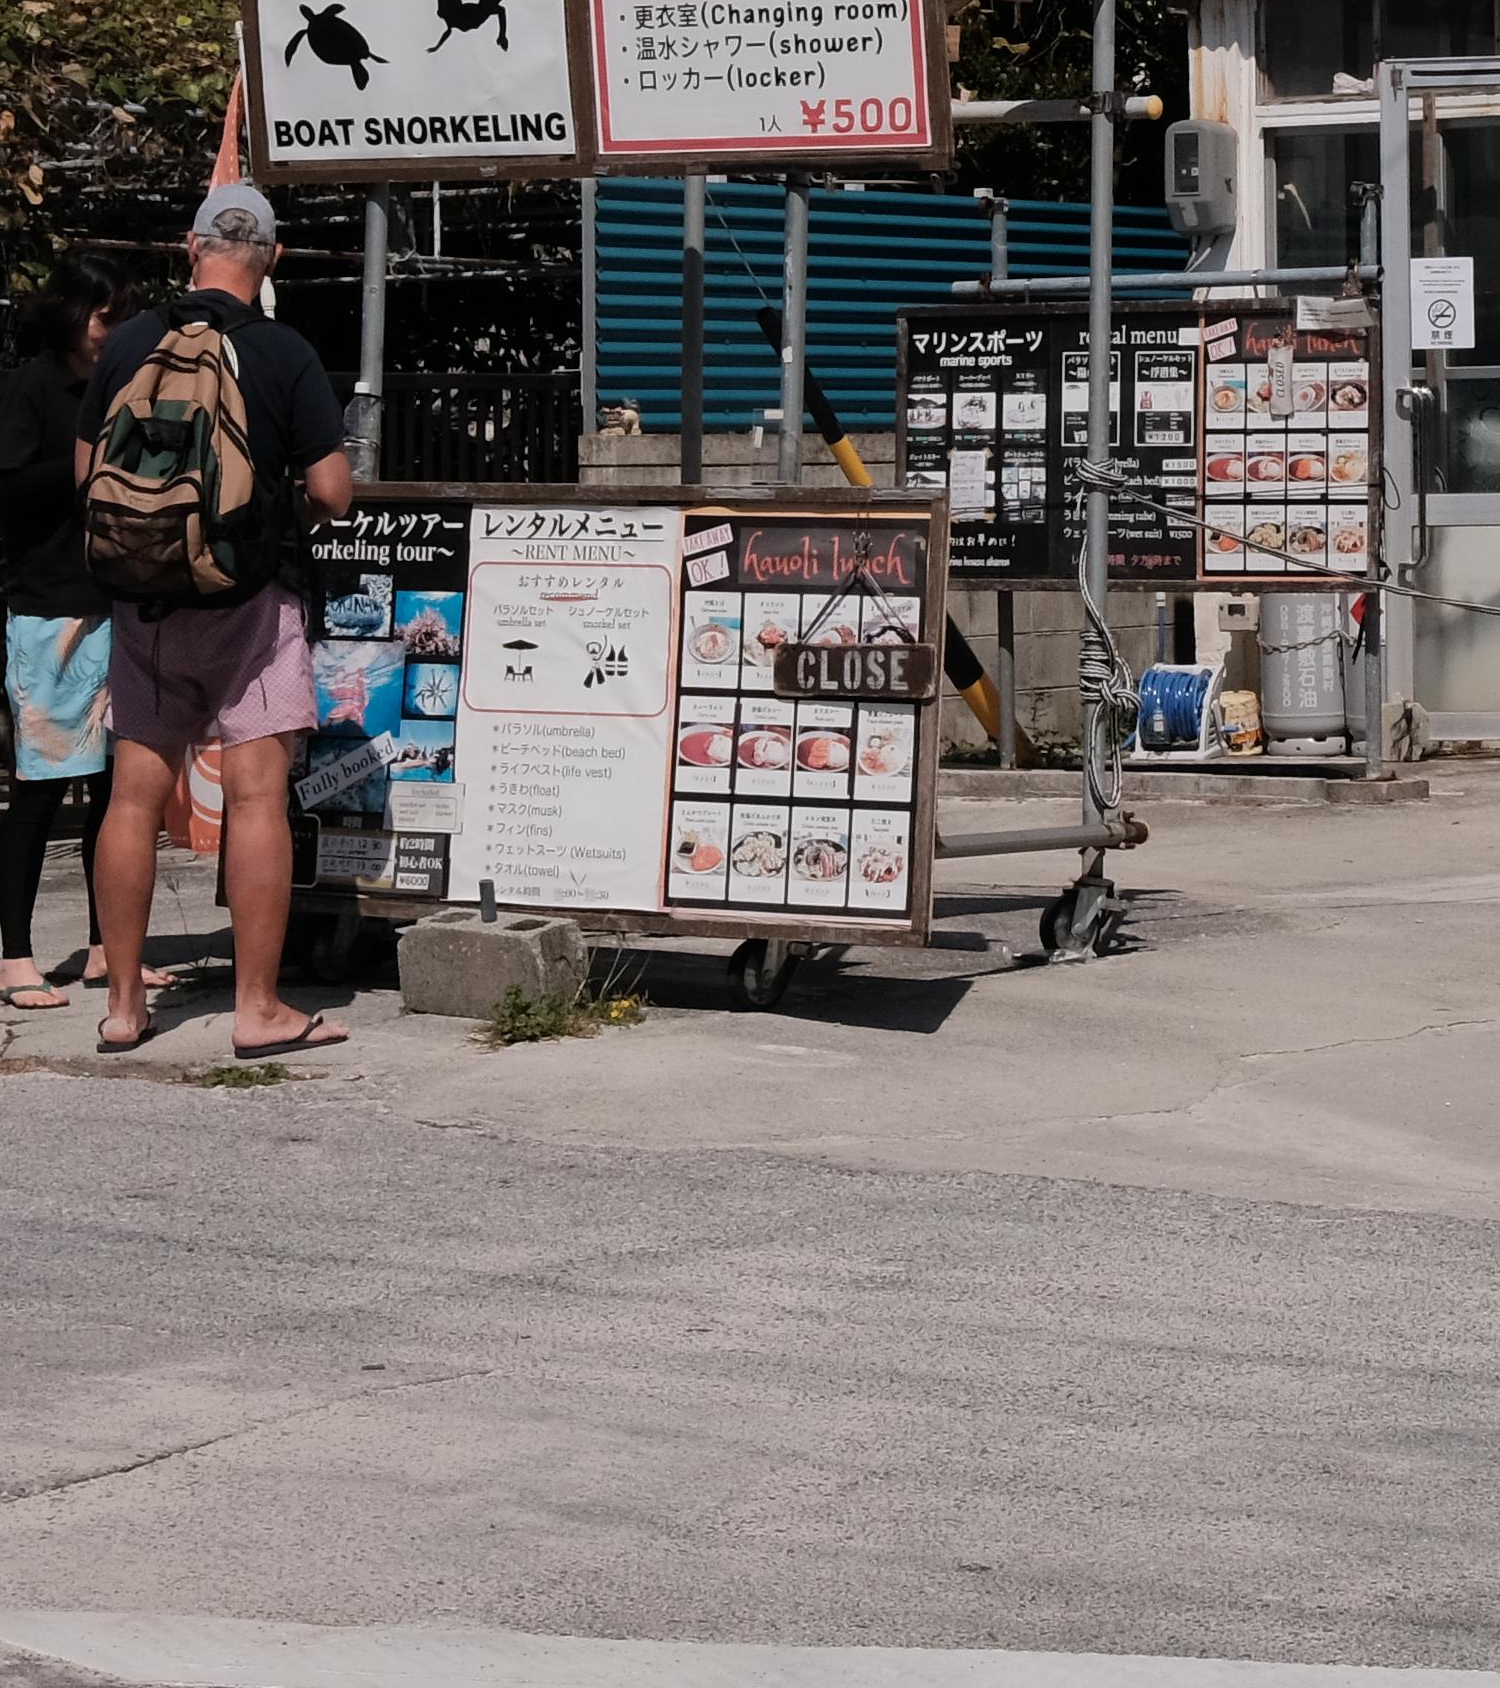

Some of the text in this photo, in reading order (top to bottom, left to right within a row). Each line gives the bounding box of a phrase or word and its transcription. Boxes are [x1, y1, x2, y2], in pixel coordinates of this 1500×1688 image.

[800, 96, 913, 134] ¥500
[274, 112, 567, 149] BOAT SNORKELING
[912, 329, 1043, 354] マリンスポーツ
[1130, 330, 1178, 345] menu
[940, 355, 1012, 368] marine sports
[1275, 361, 1285, 398] CLOSED
[484, 511, 664, 540] レンタルメニュー
[311, 539, 390, 566] orkeling
[518, 574, 625, 589] おすすめレンタル
[493, 604, 650, 618] パラソルセット シュノーケルセット
[796, 649, 911, 692] CLOSE
[299, 738, 395, 802] Fully booked
